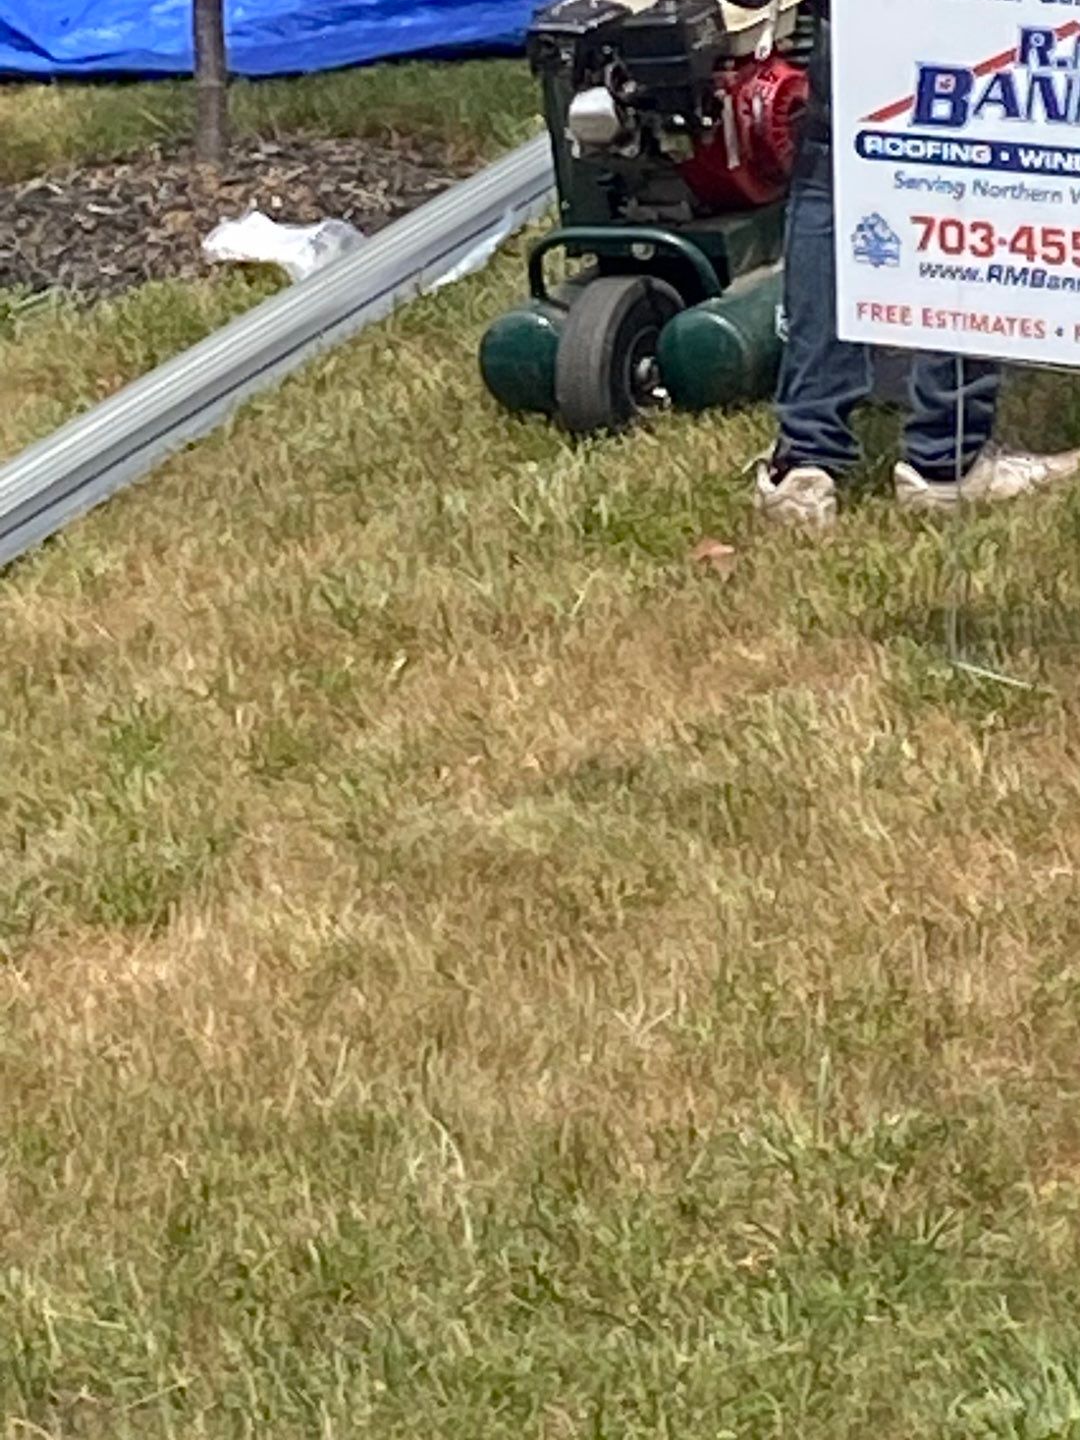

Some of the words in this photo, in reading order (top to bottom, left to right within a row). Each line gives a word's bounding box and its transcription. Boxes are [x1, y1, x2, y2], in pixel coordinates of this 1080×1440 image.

[862, 136, 992, 166] ROOFING
[893, 170, 966, 200] Serving
[972, 173, 1064, 205] Northern
[856, 301, 912, 328] FREE
[921, 307, 1046, 341] ESTIMATES
